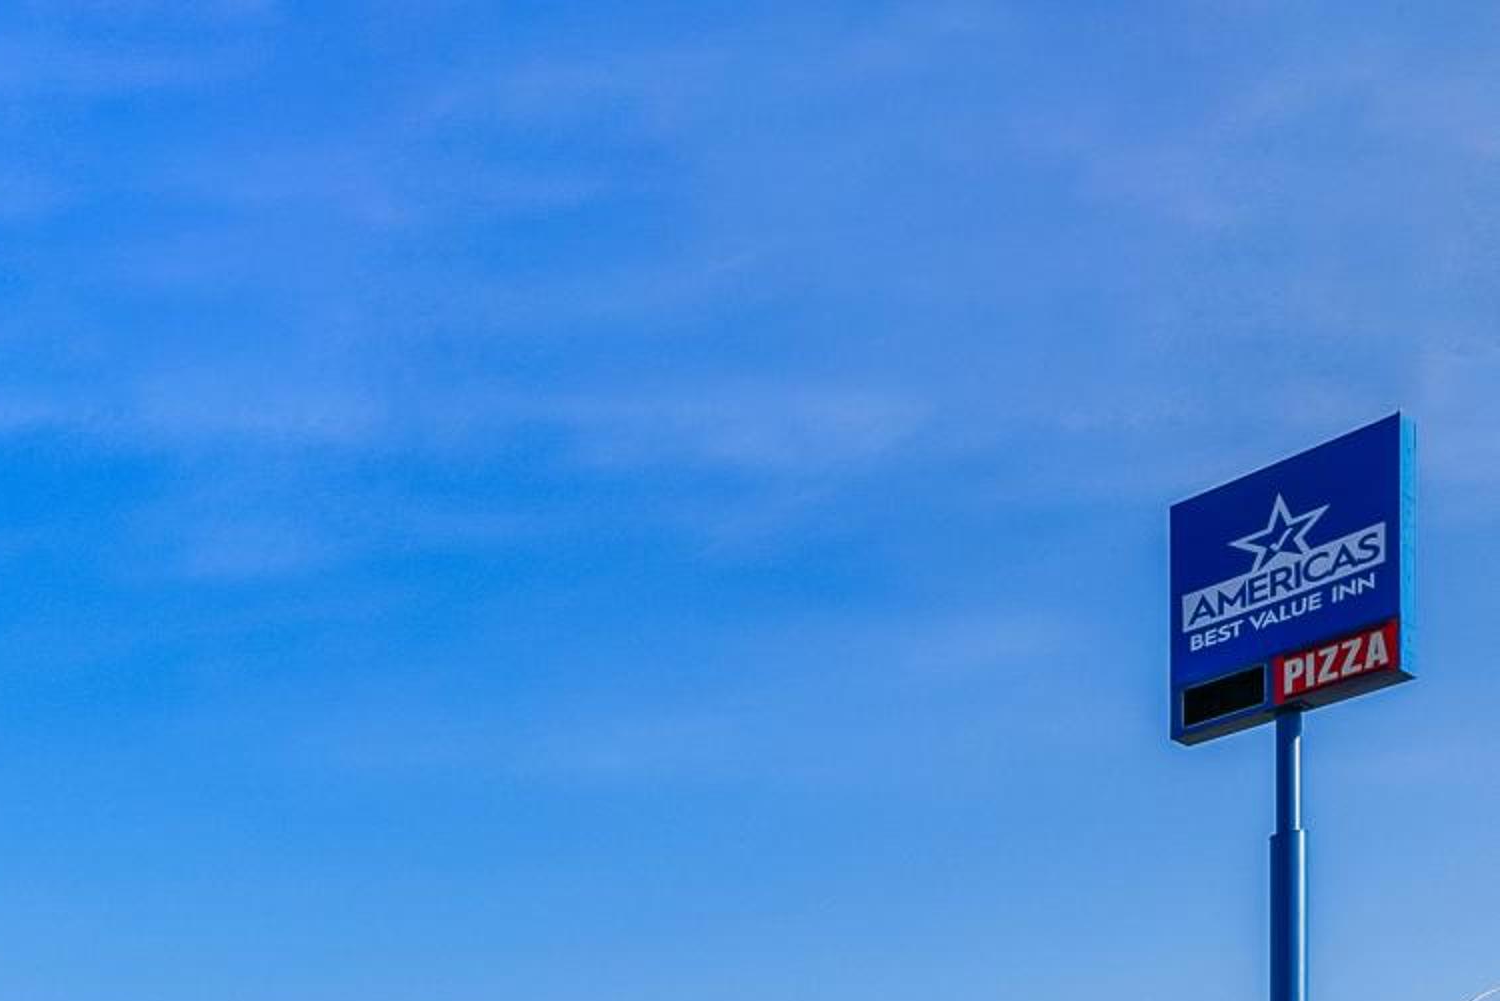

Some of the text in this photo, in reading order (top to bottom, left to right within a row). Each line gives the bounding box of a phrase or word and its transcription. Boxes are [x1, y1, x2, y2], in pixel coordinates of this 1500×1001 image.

[1189, 531, 1381, 625] AMERICAS
[1190, 573, 1375, 651] BEST VALUE INN
[1283, 631, 1389, 695] PIZZA
